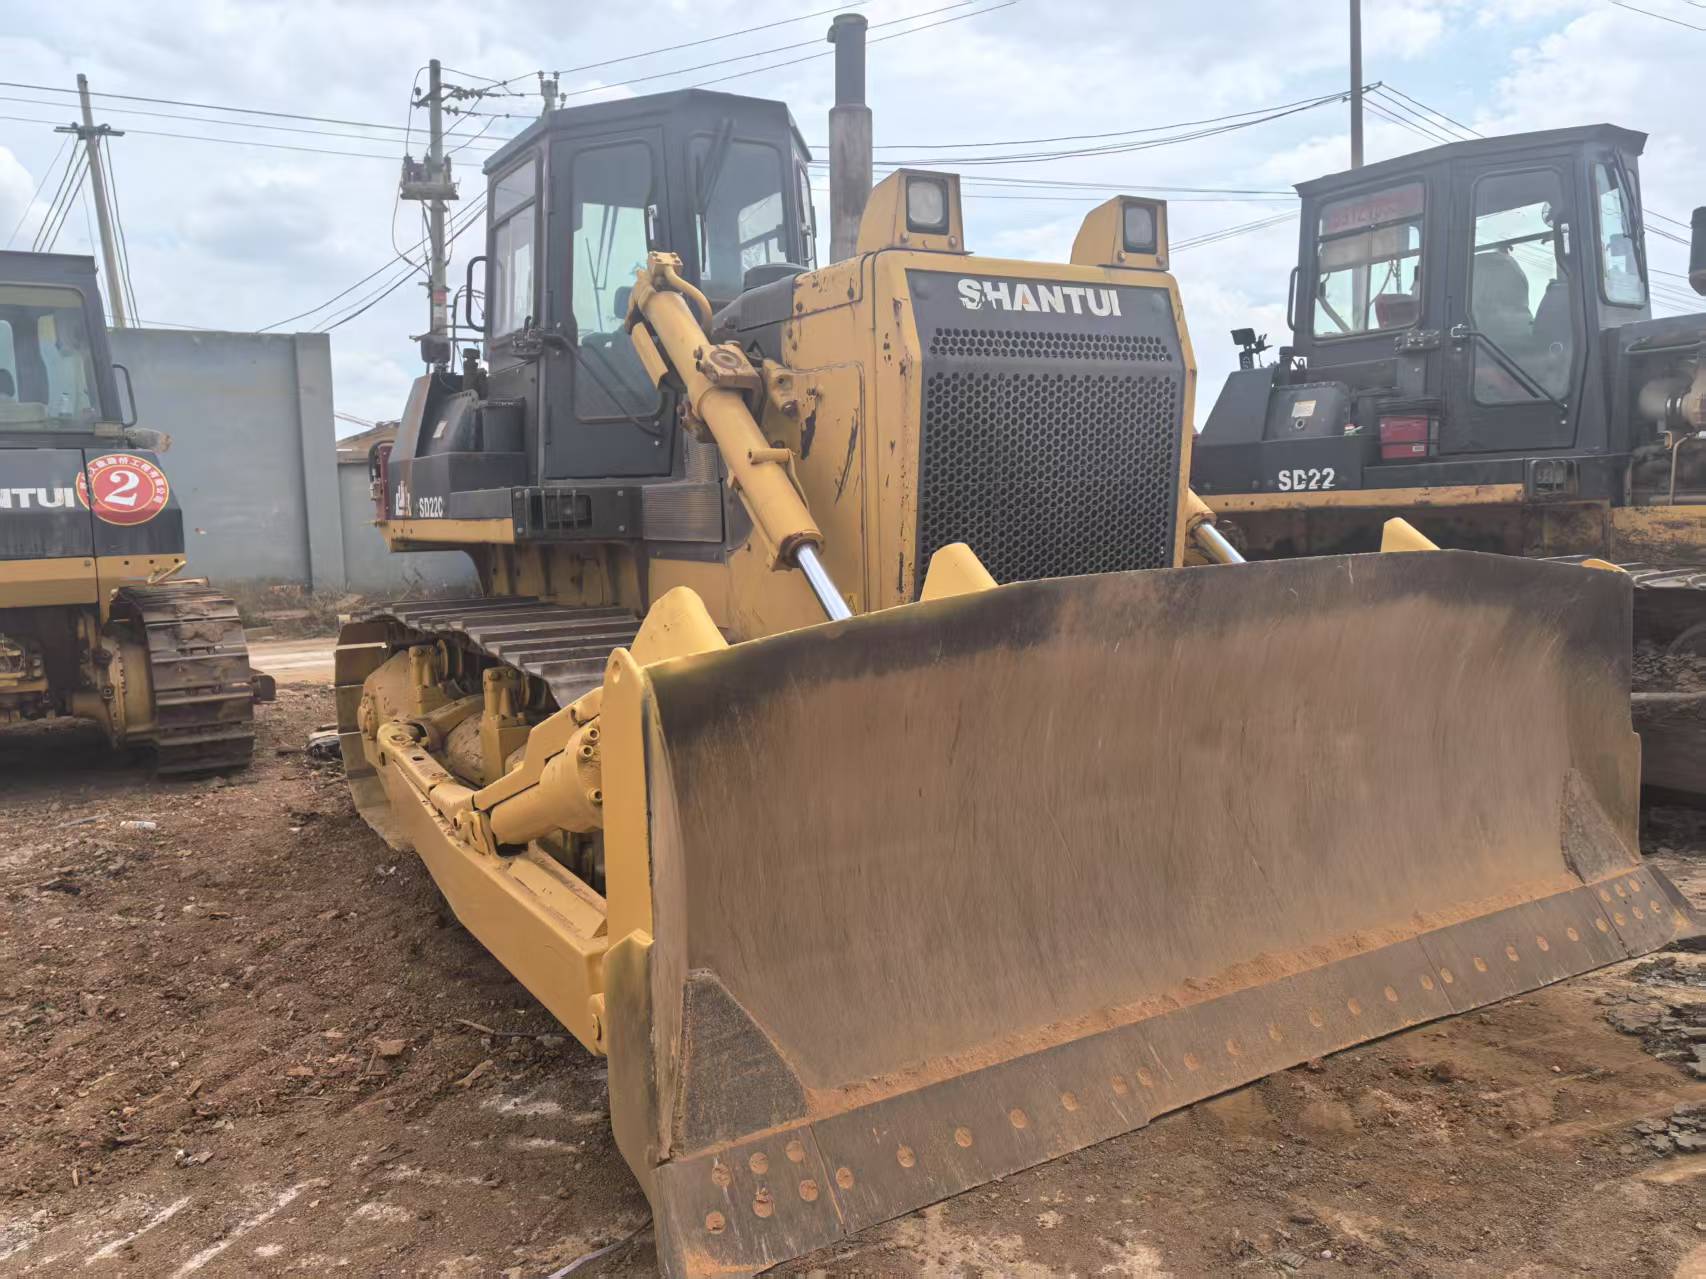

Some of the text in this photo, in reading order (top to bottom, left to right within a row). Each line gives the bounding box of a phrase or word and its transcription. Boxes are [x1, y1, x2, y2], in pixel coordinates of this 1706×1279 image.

[957, 278, 1122, 316] SHANTUI
[104, 470, 140, 507] 2
[1278, 467, 1336, 491] SD22
[419, 495, 444, 518] SD22C
